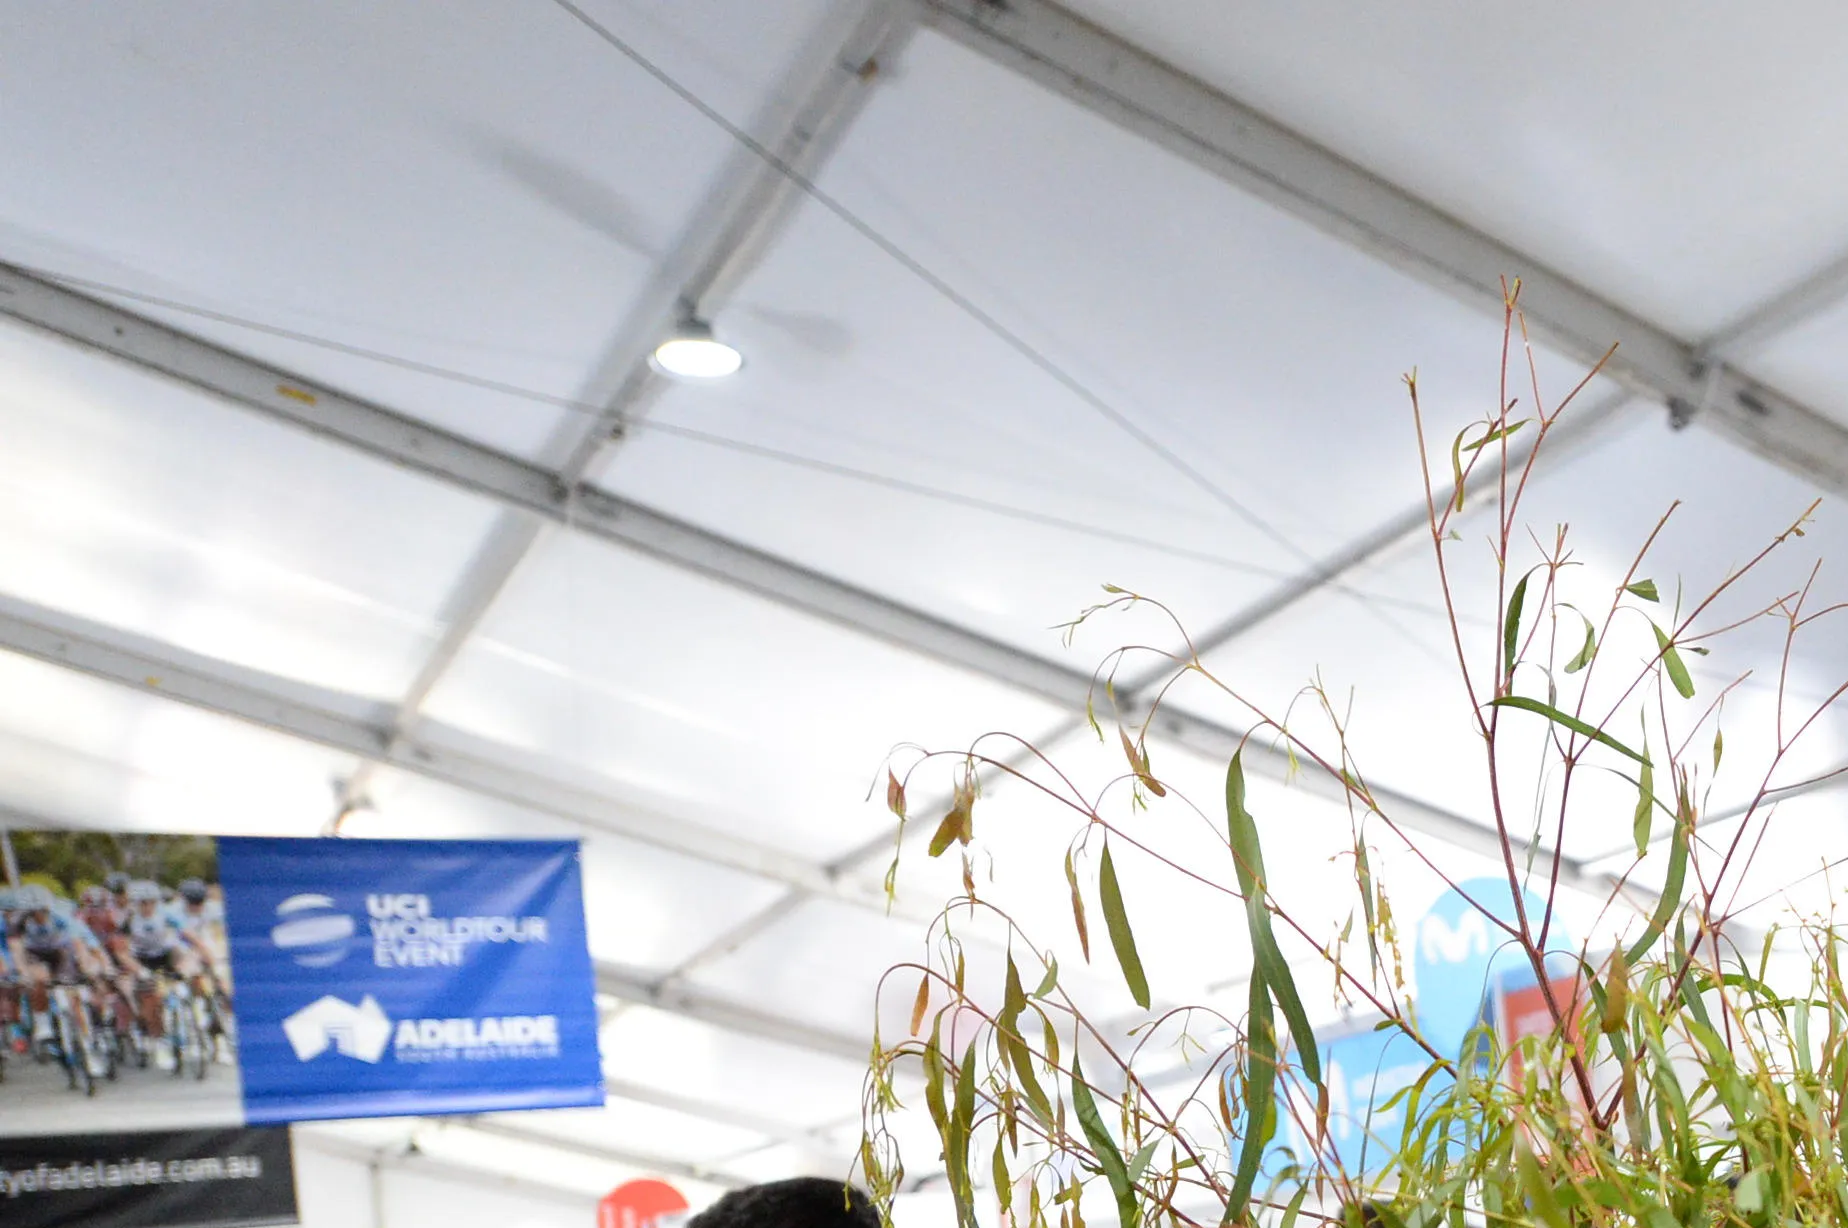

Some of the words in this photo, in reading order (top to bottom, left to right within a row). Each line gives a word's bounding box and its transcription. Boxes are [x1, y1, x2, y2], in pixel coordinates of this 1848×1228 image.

[366, 893, 430, 920] UCI
[369, 916, 548, 944] WORLDTOUR
[374, 939, 464, 968] EVENT
[395, 1015, 558, 1049] ADELAIDE
